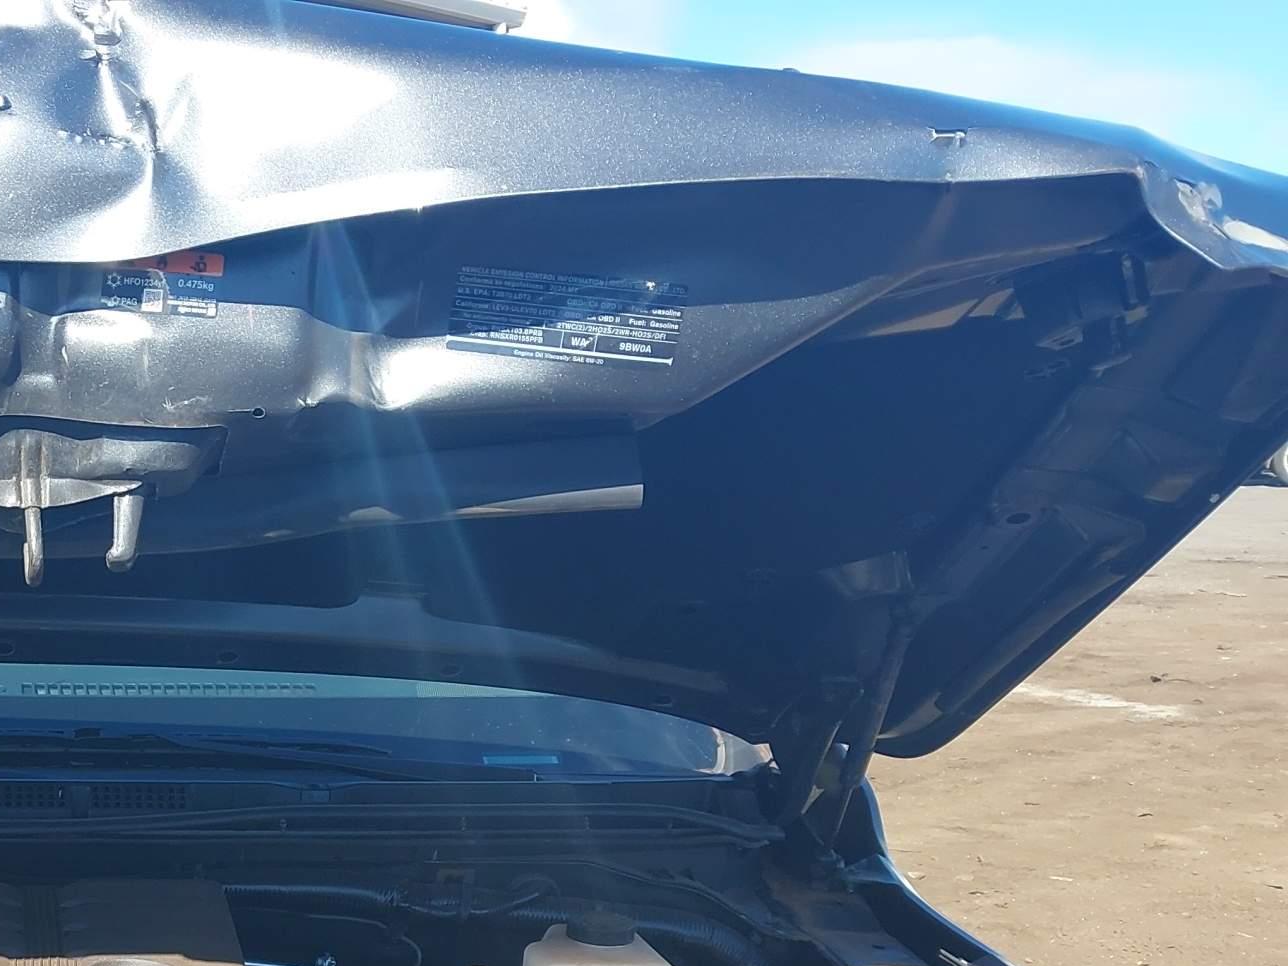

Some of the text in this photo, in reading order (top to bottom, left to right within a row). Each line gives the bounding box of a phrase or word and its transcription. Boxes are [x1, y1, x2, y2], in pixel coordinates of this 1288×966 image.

[178, 279, 215, 291] 0.475kg
[649, 319, 679, 330] Gasoline
[619, 341, 652, 353] 9BW0A
[513, 349, 533, 358] Engine
[572, 355, 585, 363] SAE
